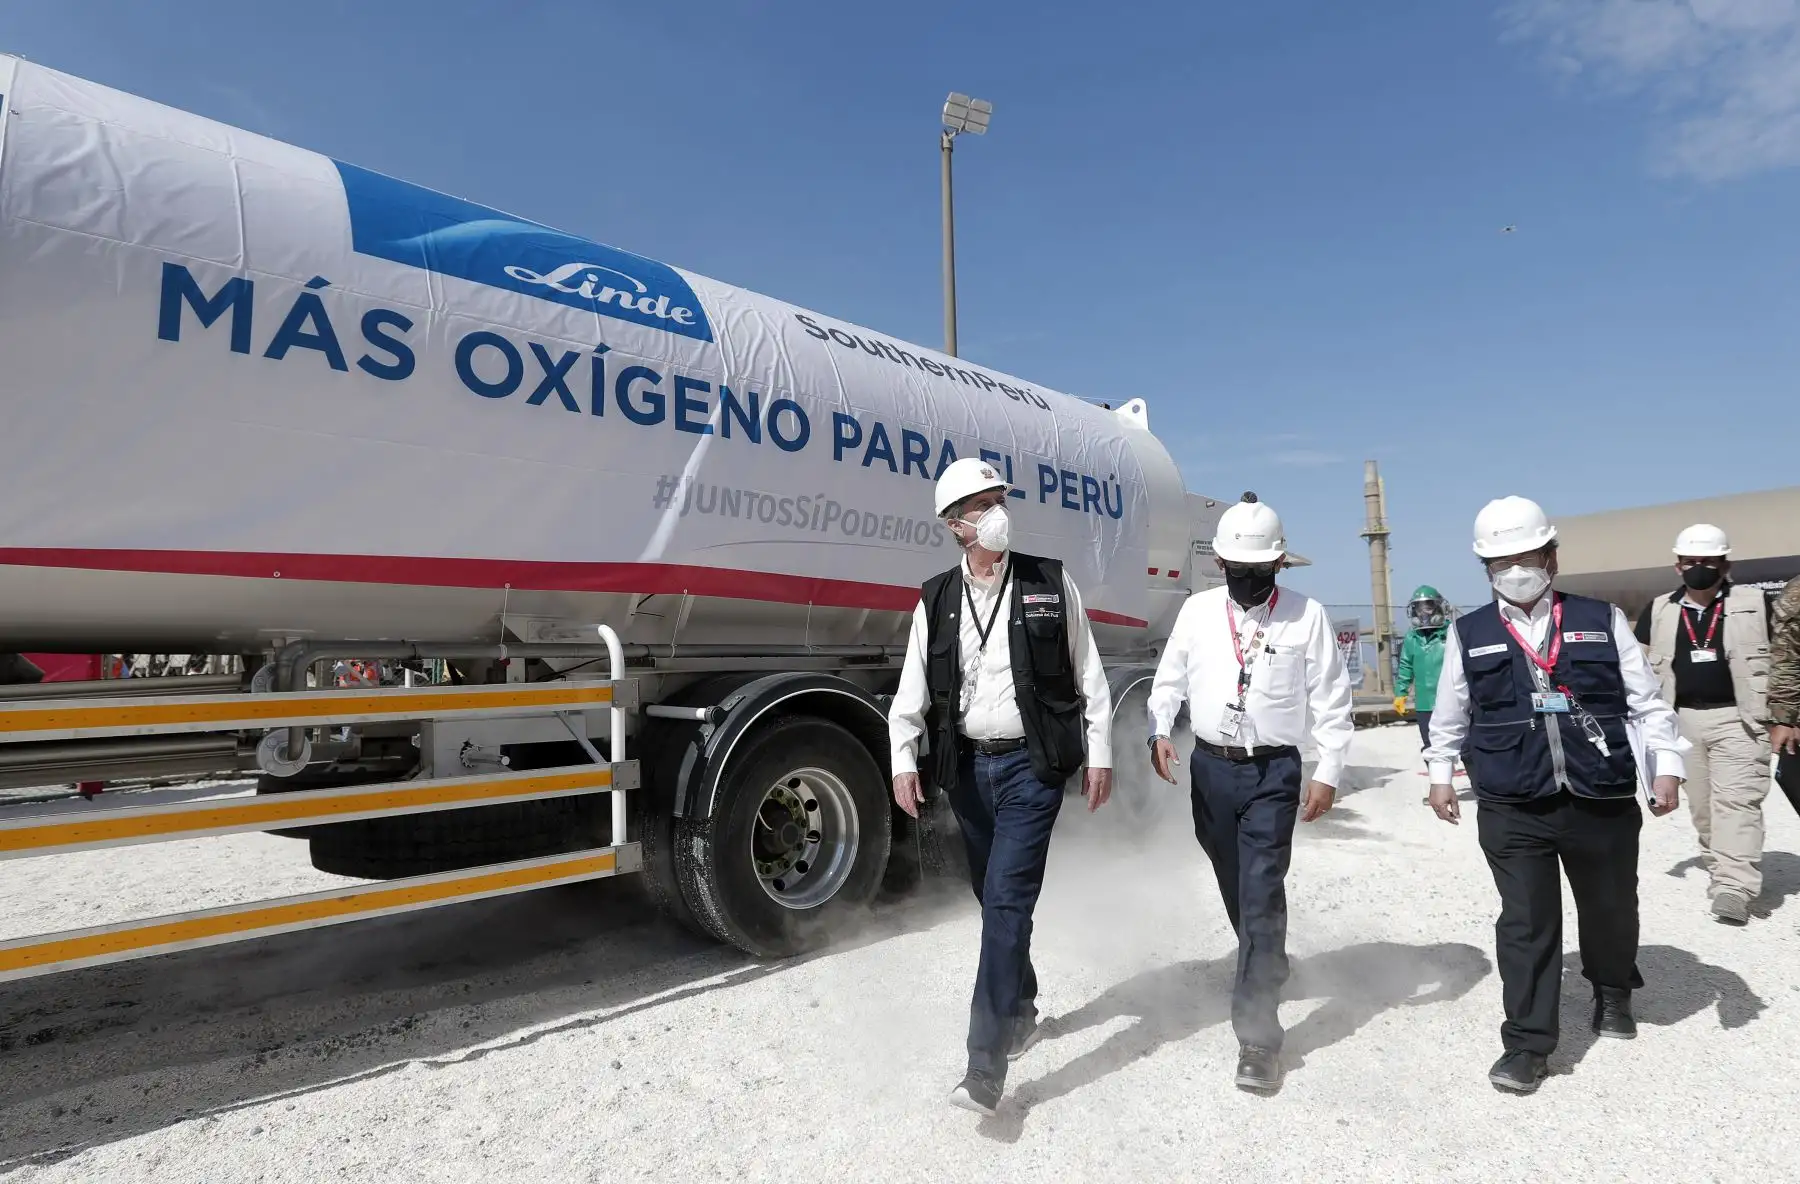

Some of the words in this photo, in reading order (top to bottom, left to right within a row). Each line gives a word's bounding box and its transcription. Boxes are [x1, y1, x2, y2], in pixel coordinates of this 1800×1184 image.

[504, 262, 696, 325] Linde
[158, 262, 415, 381] MÁS
[454, 331, 810, 453] OXÍGENO
[833, 411, 961, 483] PARA
[1038, 463, 1123, 519] PERÚ
[1337, 631, 1356, 644] 424
